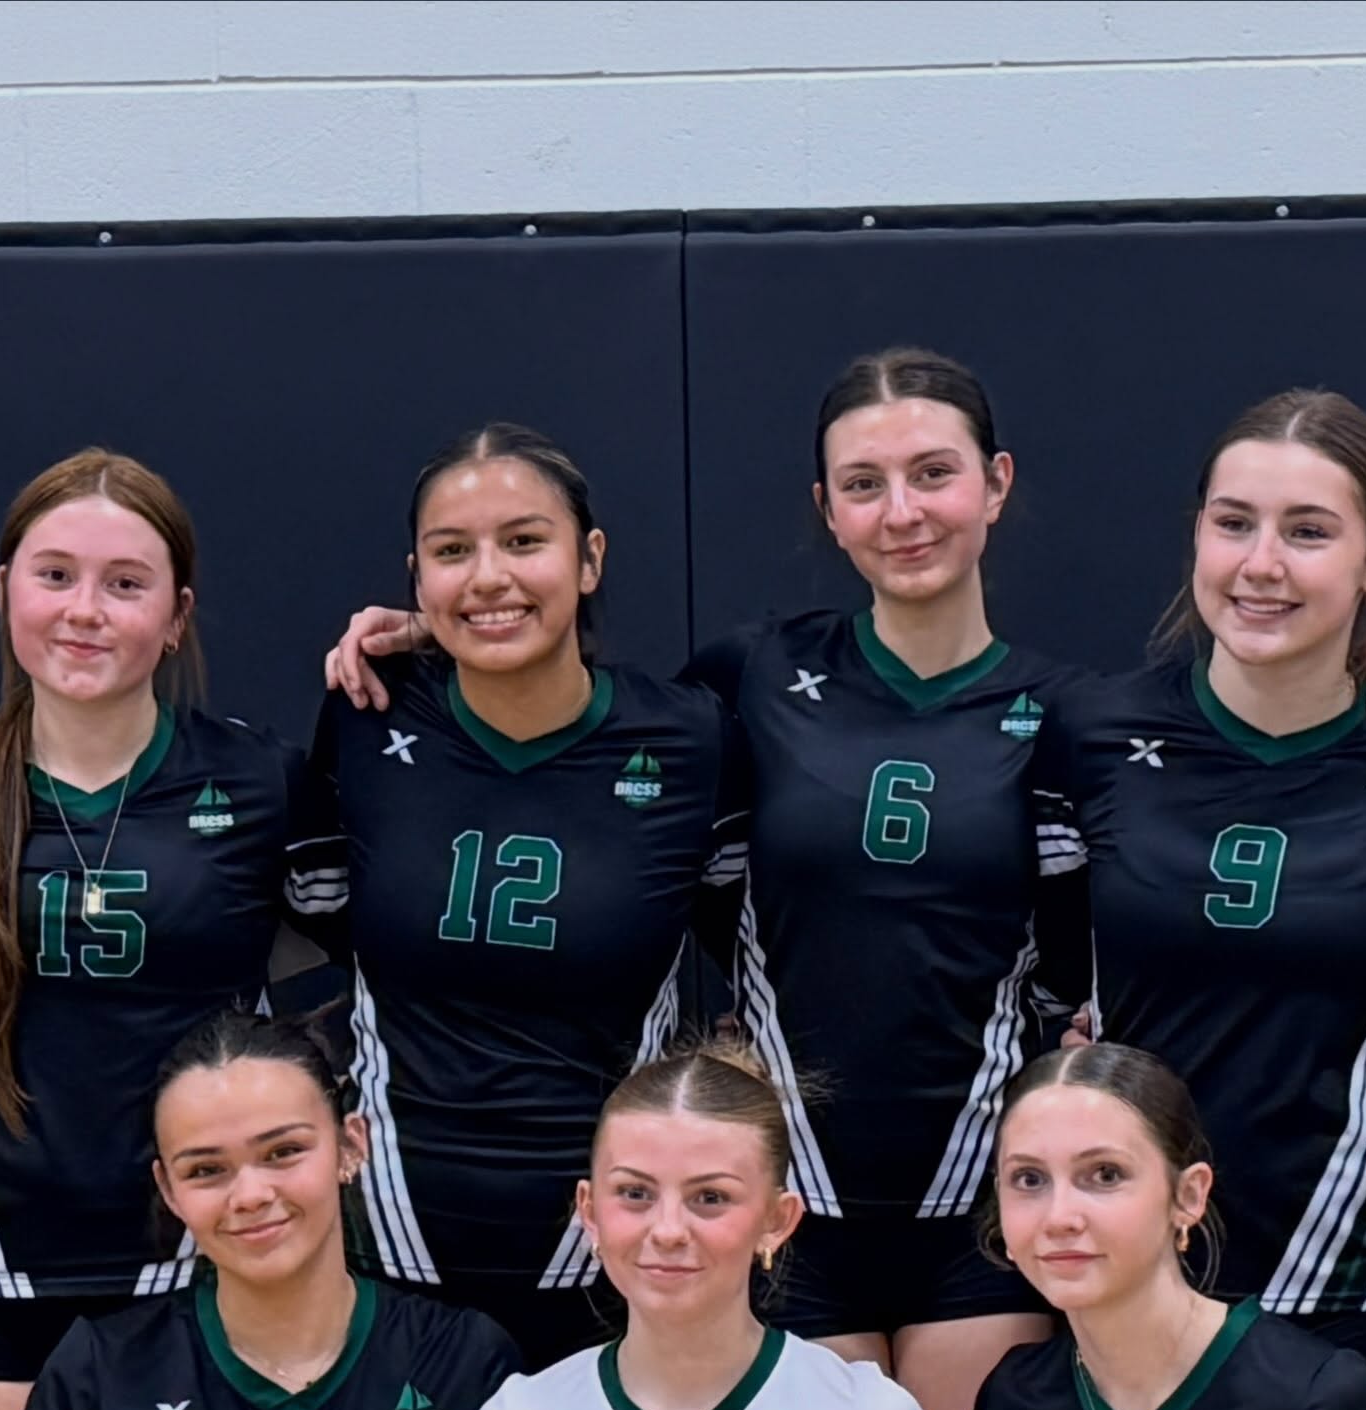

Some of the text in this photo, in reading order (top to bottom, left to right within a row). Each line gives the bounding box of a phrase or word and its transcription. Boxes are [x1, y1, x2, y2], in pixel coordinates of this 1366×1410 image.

[862, 760, 936, 864] 6
[37, 869, 147, 978] 15
[438, 830, 563, 950] 12
[1204, 824, 1288, 930] 9
